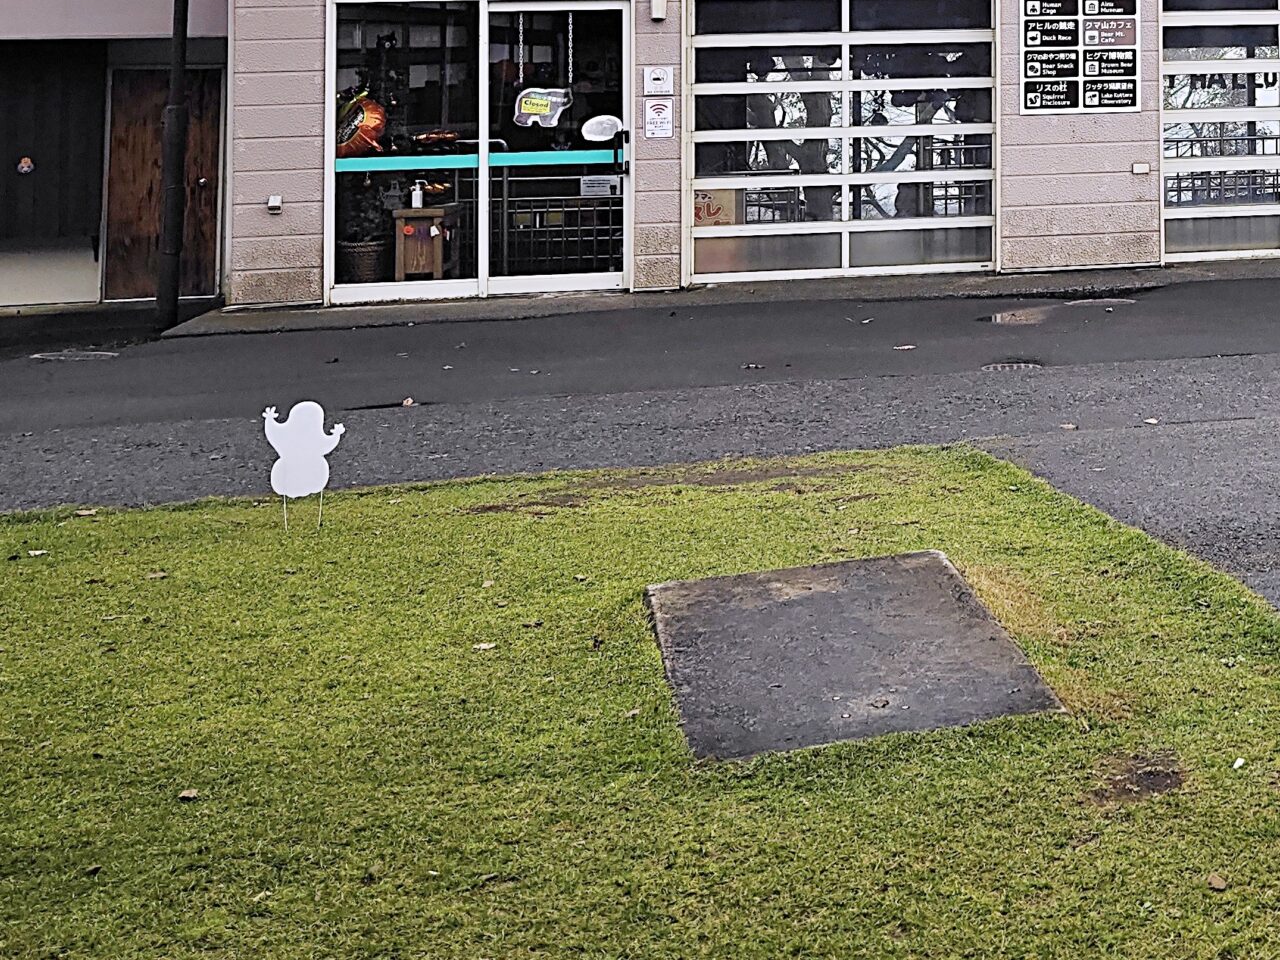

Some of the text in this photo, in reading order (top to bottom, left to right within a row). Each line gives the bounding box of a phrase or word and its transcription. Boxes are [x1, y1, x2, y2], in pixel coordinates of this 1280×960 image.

[1085, 21, 1132, 30] クマ山カフェ
[524, 99, 549, 109] Closed
